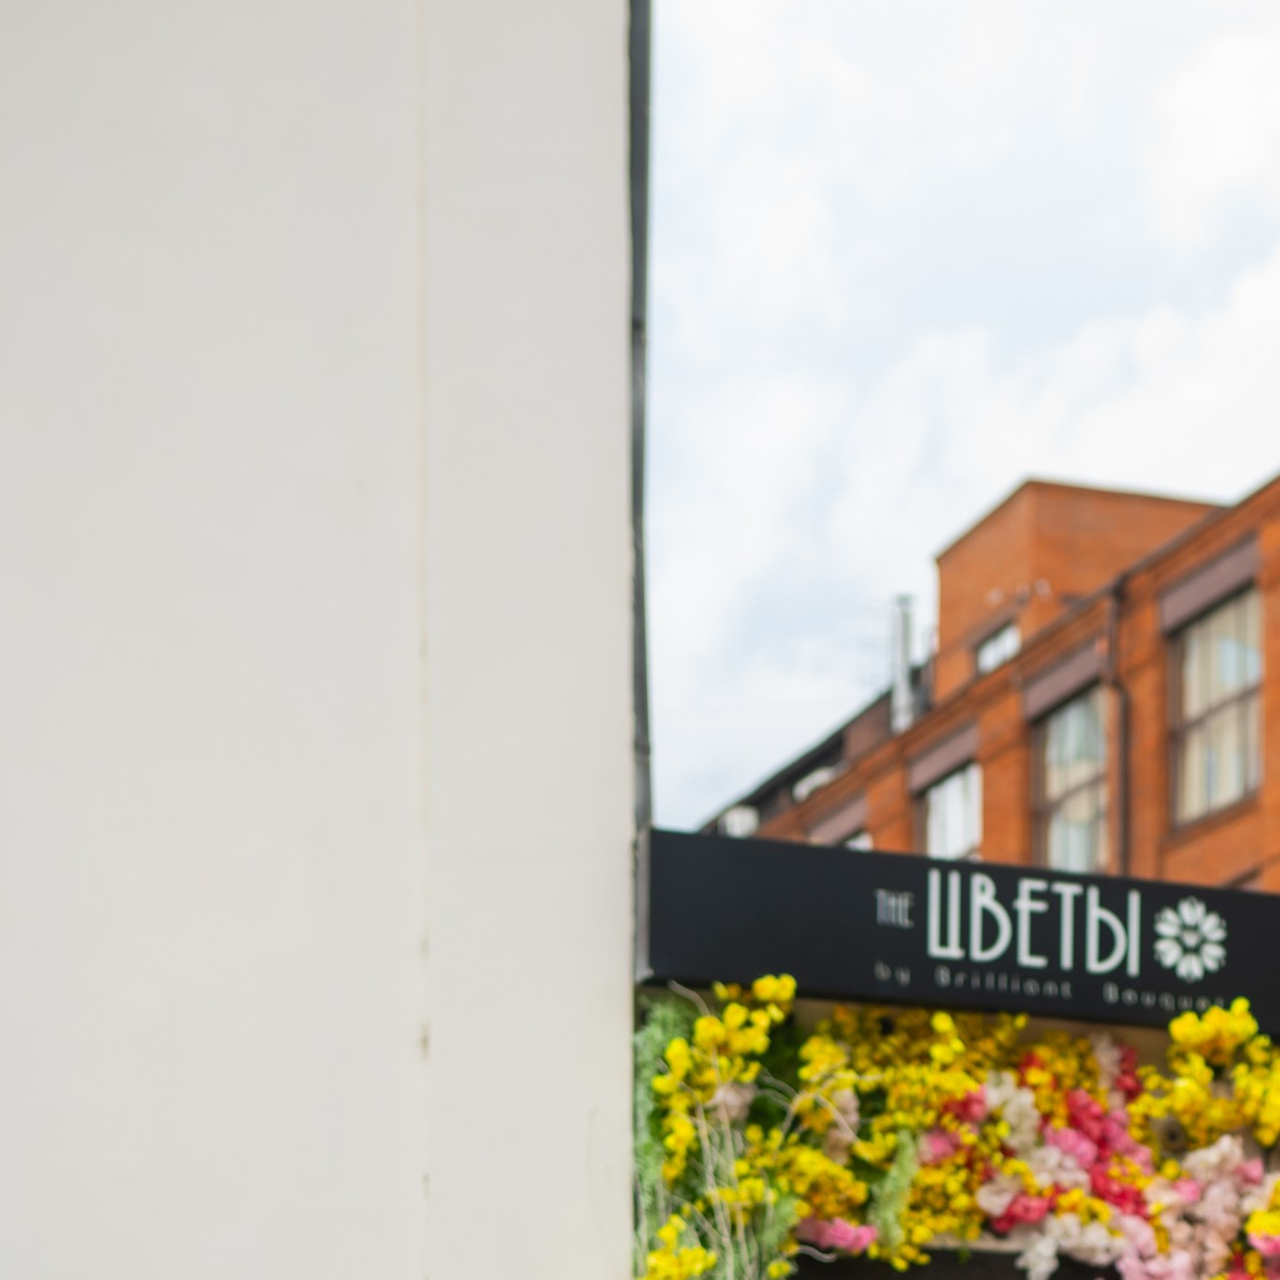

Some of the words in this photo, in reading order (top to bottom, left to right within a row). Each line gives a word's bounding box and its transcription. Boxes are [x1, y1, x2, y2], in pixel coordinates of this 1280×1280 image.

[875, 888, 914, 928] THE
[927, 867, 1140, 978] ЦВЕТЫ
[874, 960, 911, 987] by
[935, 964, 1072, 999] Brilliant
